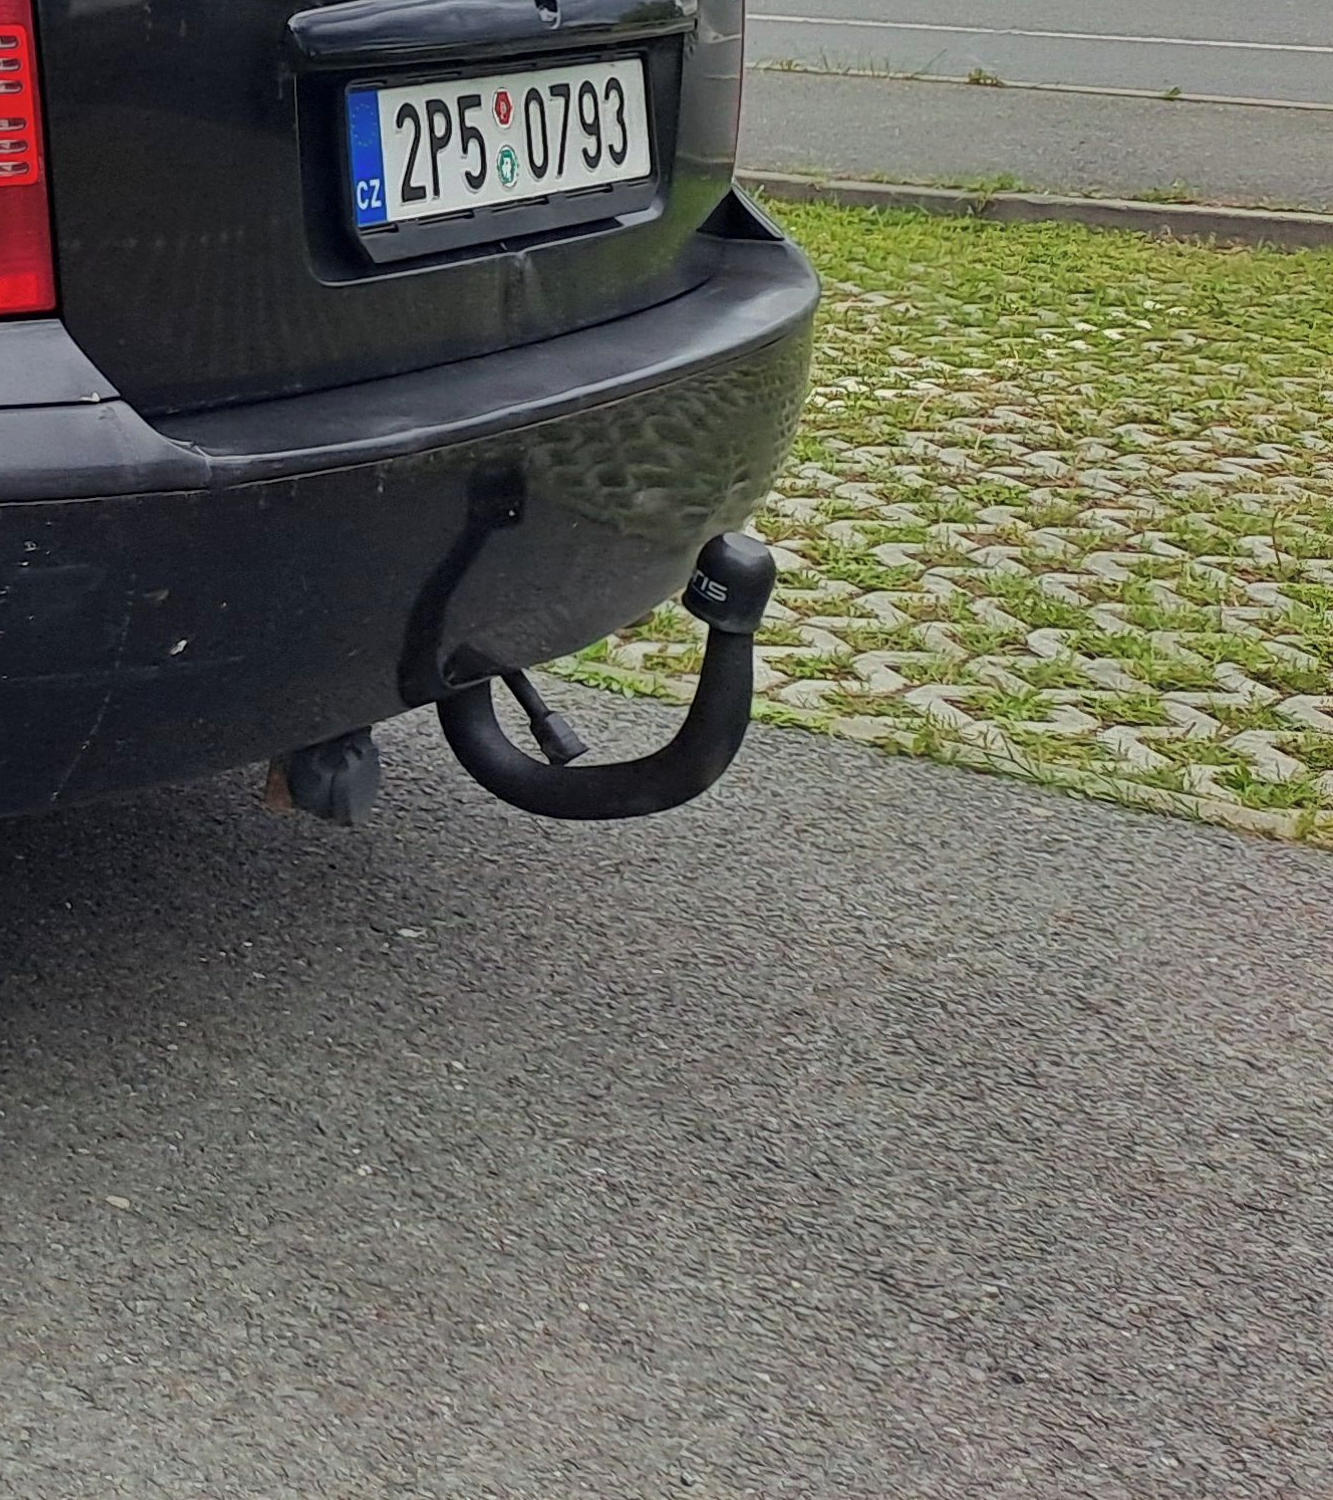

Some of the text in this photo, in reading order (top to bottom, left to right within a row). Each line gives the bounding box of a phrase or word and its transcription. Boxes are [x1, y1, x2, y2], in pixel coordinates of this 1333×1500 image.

[395, 76, 629, 203] 2P5 0793
[356, 179, 383, 211] CZ
